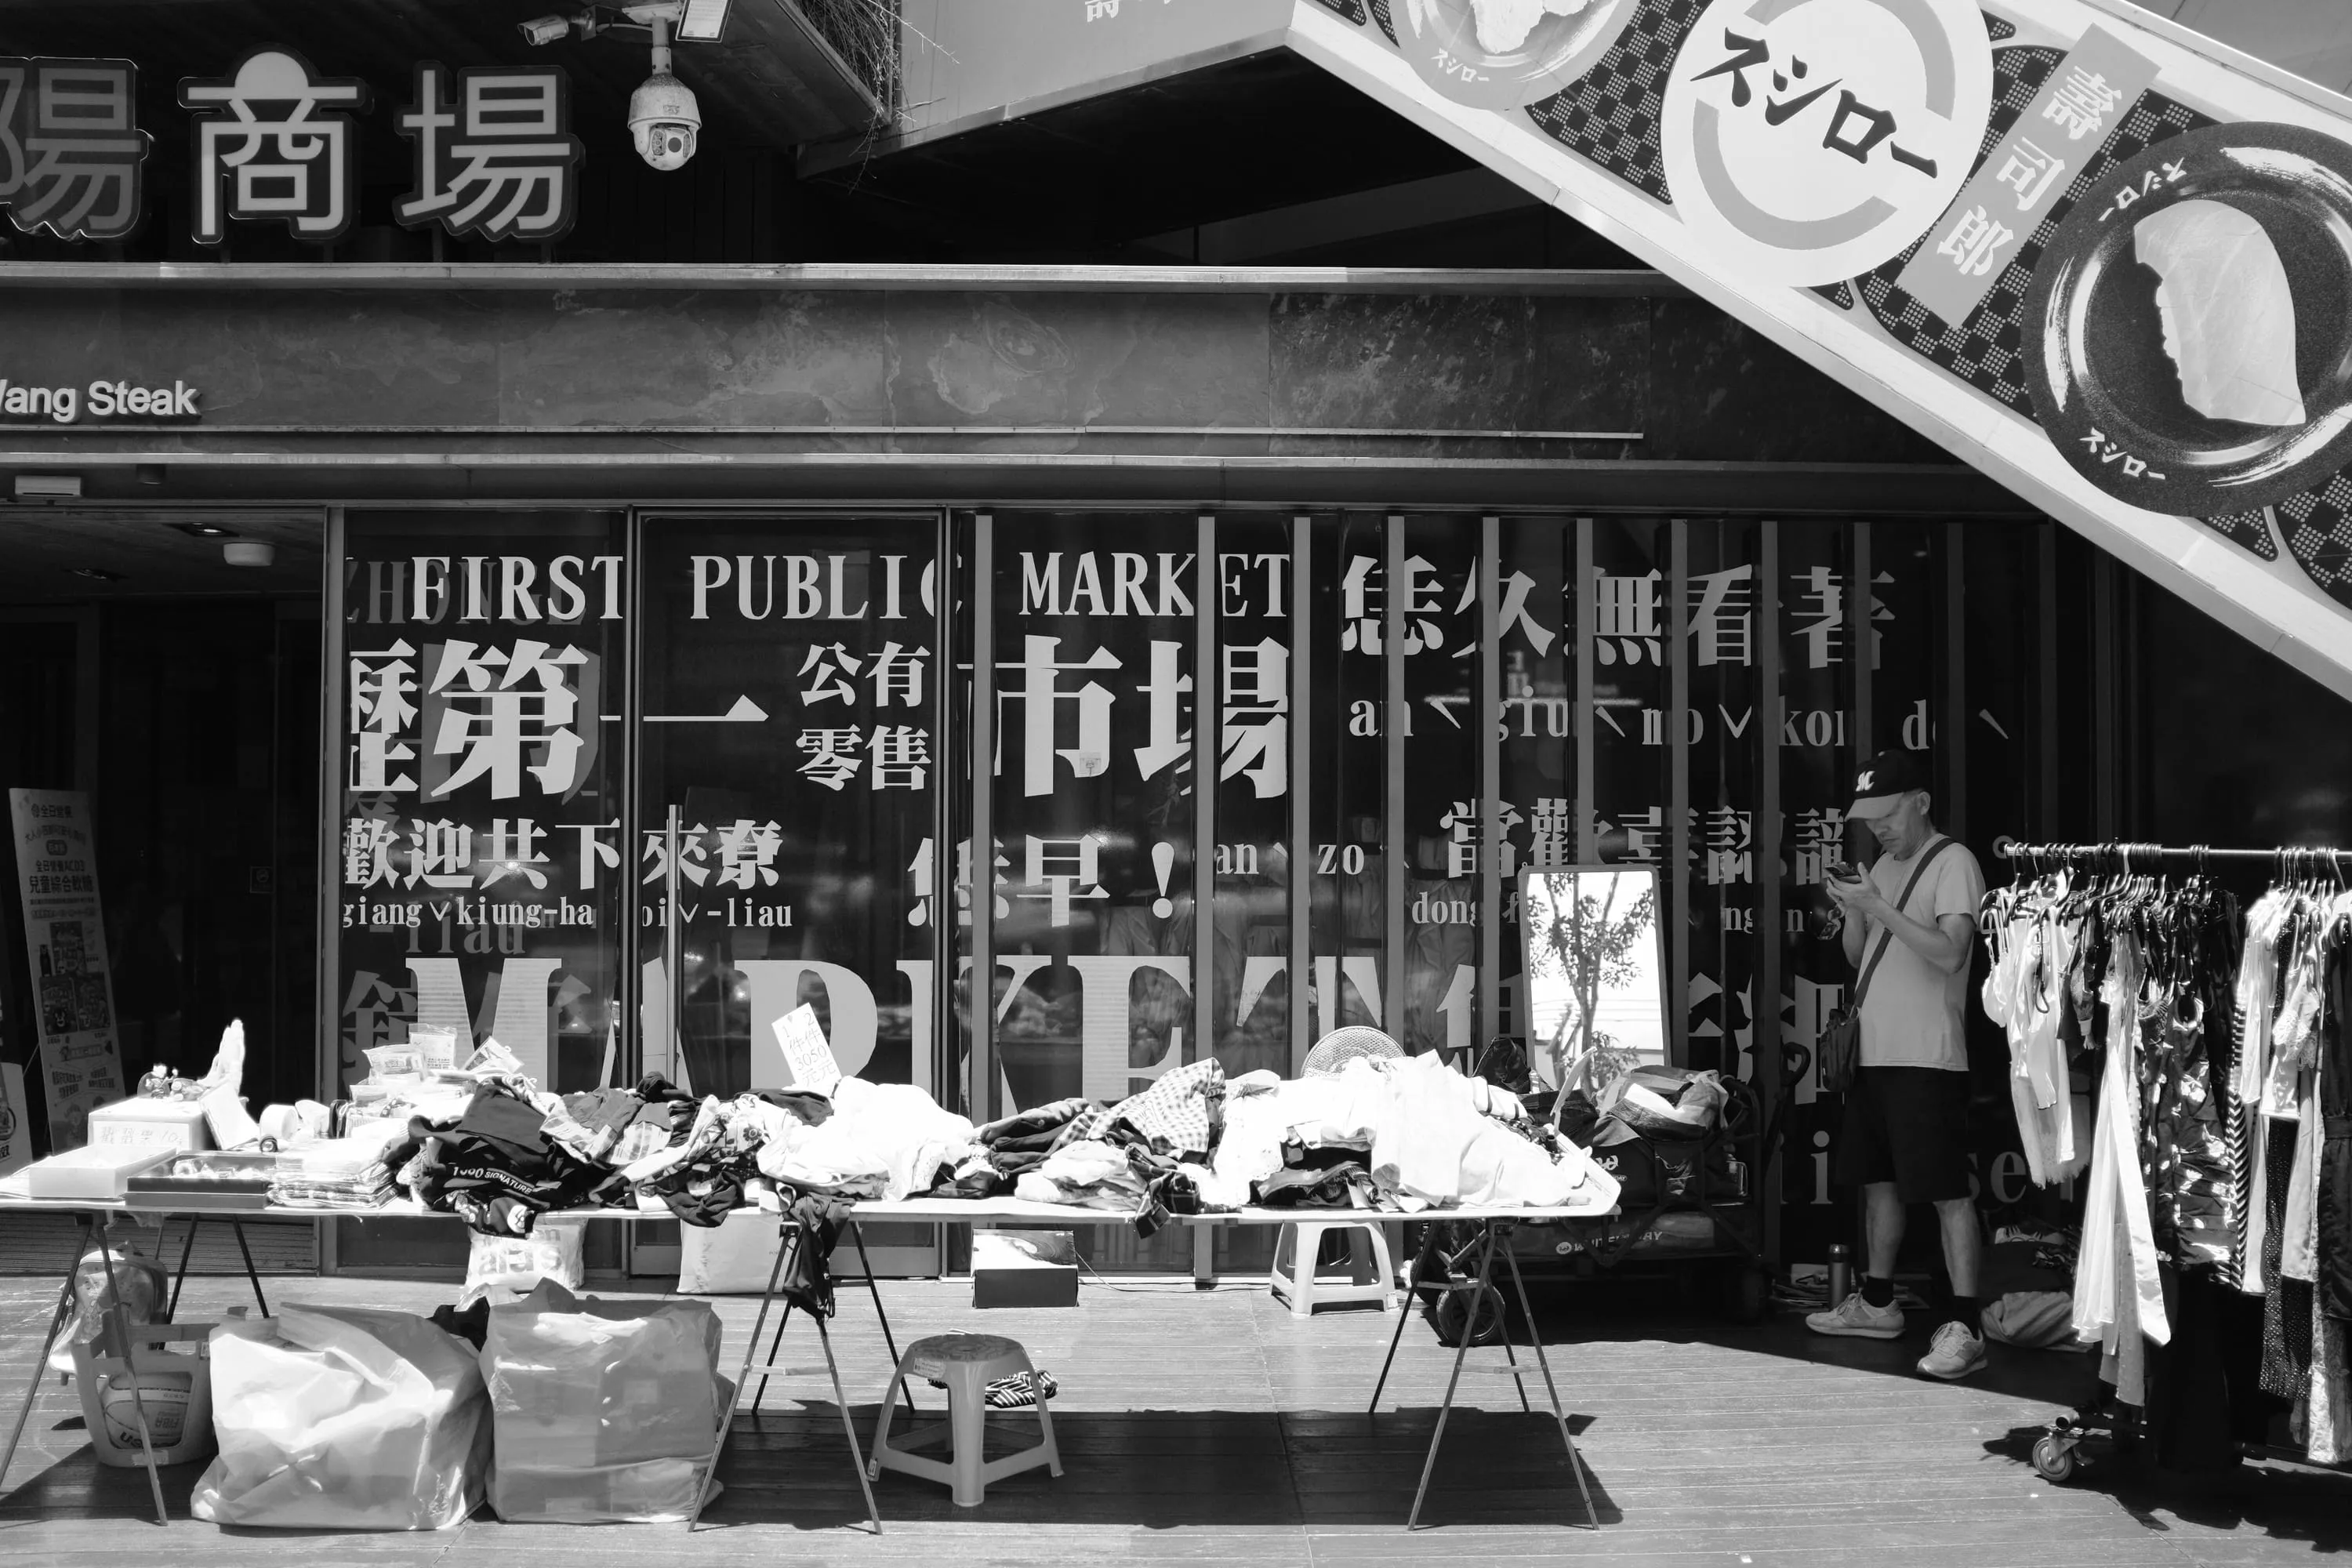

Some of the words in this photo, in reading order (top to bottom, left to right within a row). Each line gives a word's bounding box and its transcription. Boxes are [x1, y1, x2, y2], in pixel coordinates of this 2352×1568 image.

[1690, 27, 1938, 180] スシロー
[1937, 65, 2122, 278] 壽司郎
[87, 379, 198, 417] Steak
[2079, 427, 2166, 481] スシロー
[411, 555, 624, 620] FIRST
[1019, 551, 1290, 618] MARKET
[797, 641, 931, 708] 公有
[796, 724, 932, 792] 零售
[485, 1171, 534, 1196] SIGNATURE
